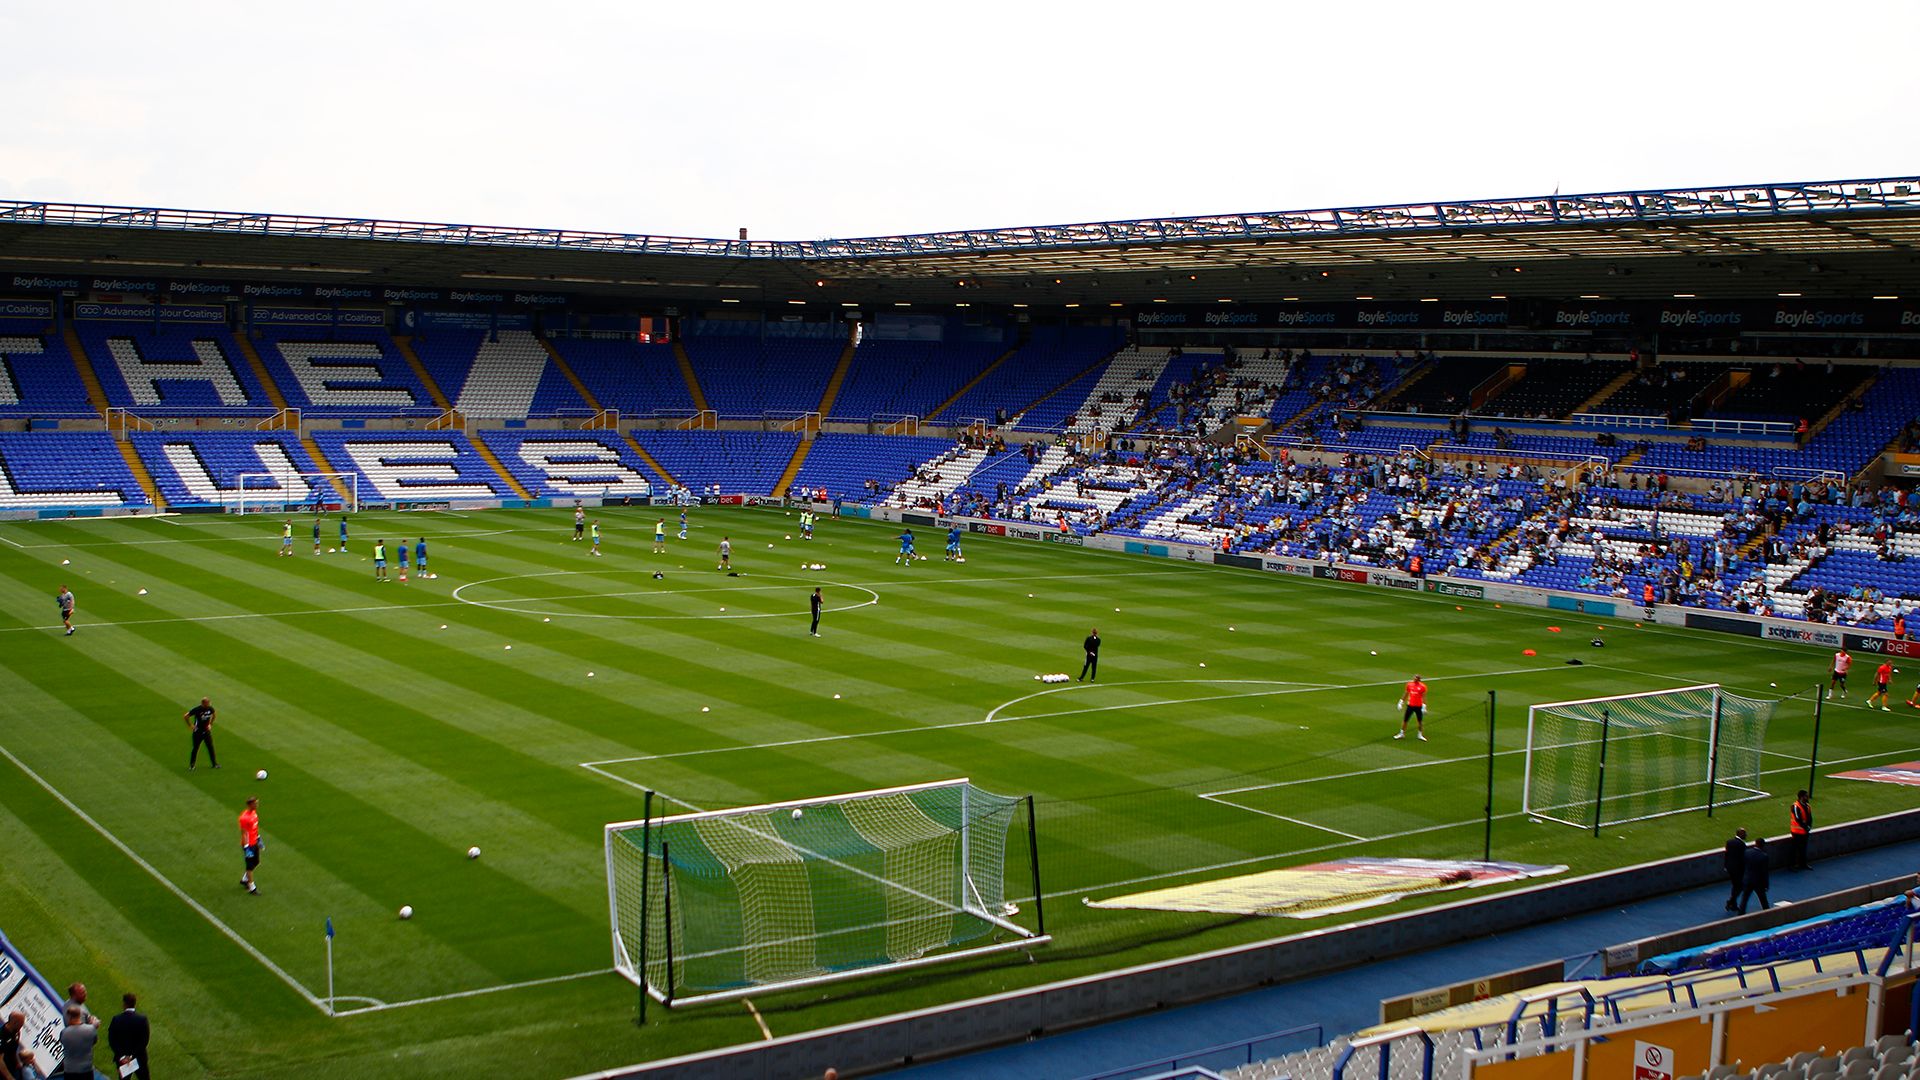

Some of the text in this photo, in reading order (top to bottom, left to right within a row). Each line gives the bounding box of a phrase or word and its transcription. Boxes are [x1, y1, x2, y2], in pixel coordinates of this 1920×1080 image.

[13, 276, 79, 290] BoyleSports
[93, 279, 157, 292] BoyleSports
[170, 281, 232, 294] BoyleSports
[244, 284, 303, 296] BoyleSports
[315, 286, 372, 299] BoyleSports
[384, 289, 440, 301] BoyleSports
[450, 291, 504, 303] BoyleSports
[514, 293, 566, 305] BoyleSports
[103, 307, 150, 317] Advanced
[182, 309, 223, 320] Coatings
[271, 311, 315, 321] Advanced
[344, 313, 382, 323] Coatings
[1138, 312, 1187, 324] BoyleSports
[1205, 312, 1258, 325] BoyleSports
[1278, 311, 1336, 325] BoyleSports
[1357, 310, 1419, 324] BoyleSports
[1556, 310, 1631, 326] BoyleSports
[1660, 310, 1742, 327] BoyleSports
[1774, 310, 1864, 327] BoyleSports
[1325, 568, 1355, 581] sky bet
[1384, 577, 1418, 590] hummel
[1439, 583, 1482, 599] Carabao
[1768, 627, 1813, 641] SCREWFIX
[1862, 638, 1909, 654] sky bet
